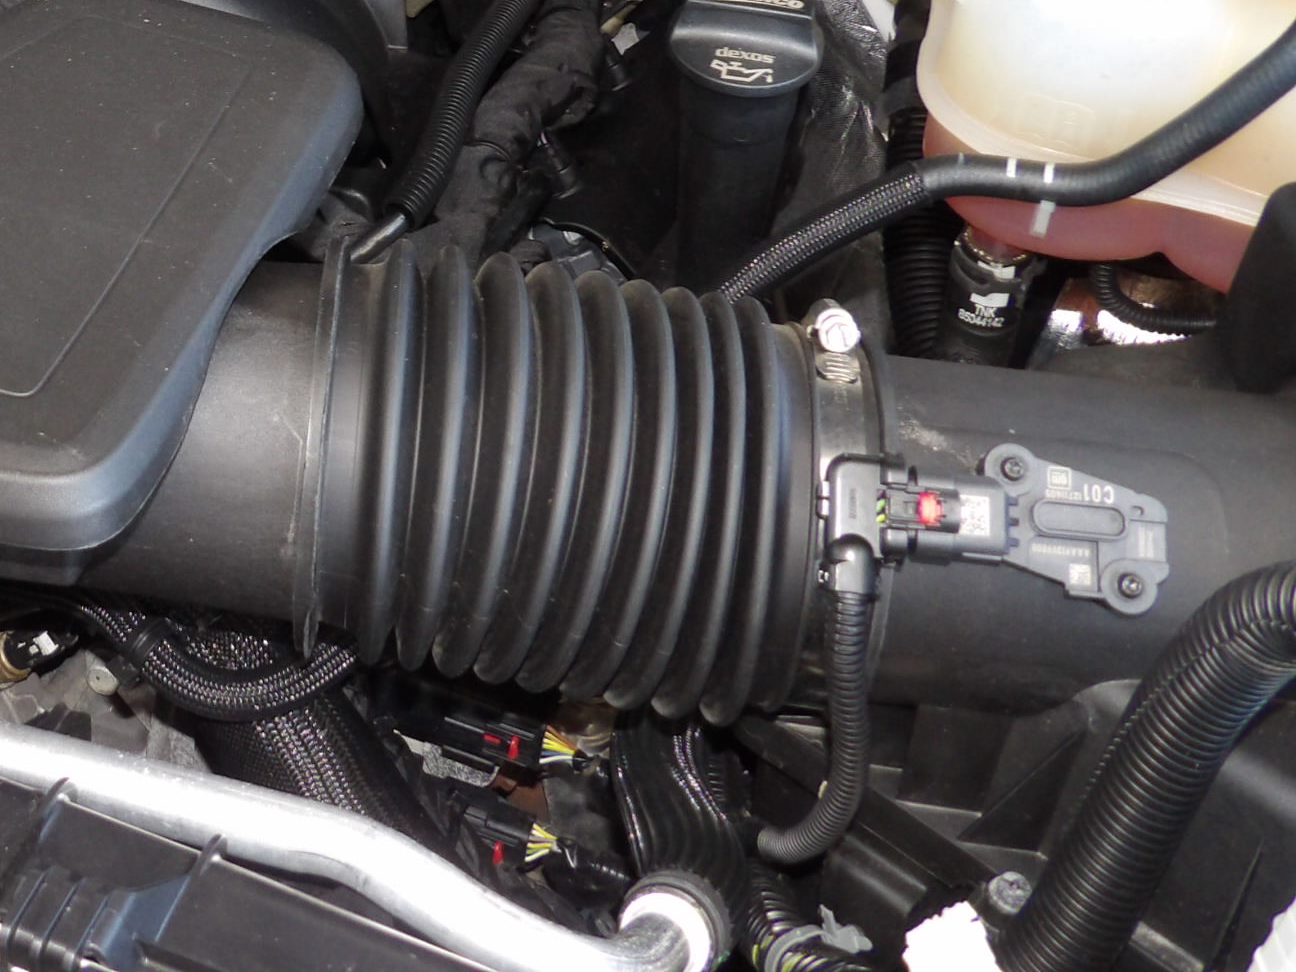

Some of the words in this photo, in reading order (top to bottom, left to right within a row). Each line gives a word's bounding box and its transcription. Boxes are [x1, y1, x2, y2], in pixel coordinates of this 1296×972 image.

[714, 47, 774, 64] dexos
[975, 303, 998, 318] TNK
[1083, 484, 1115, 504] C01
